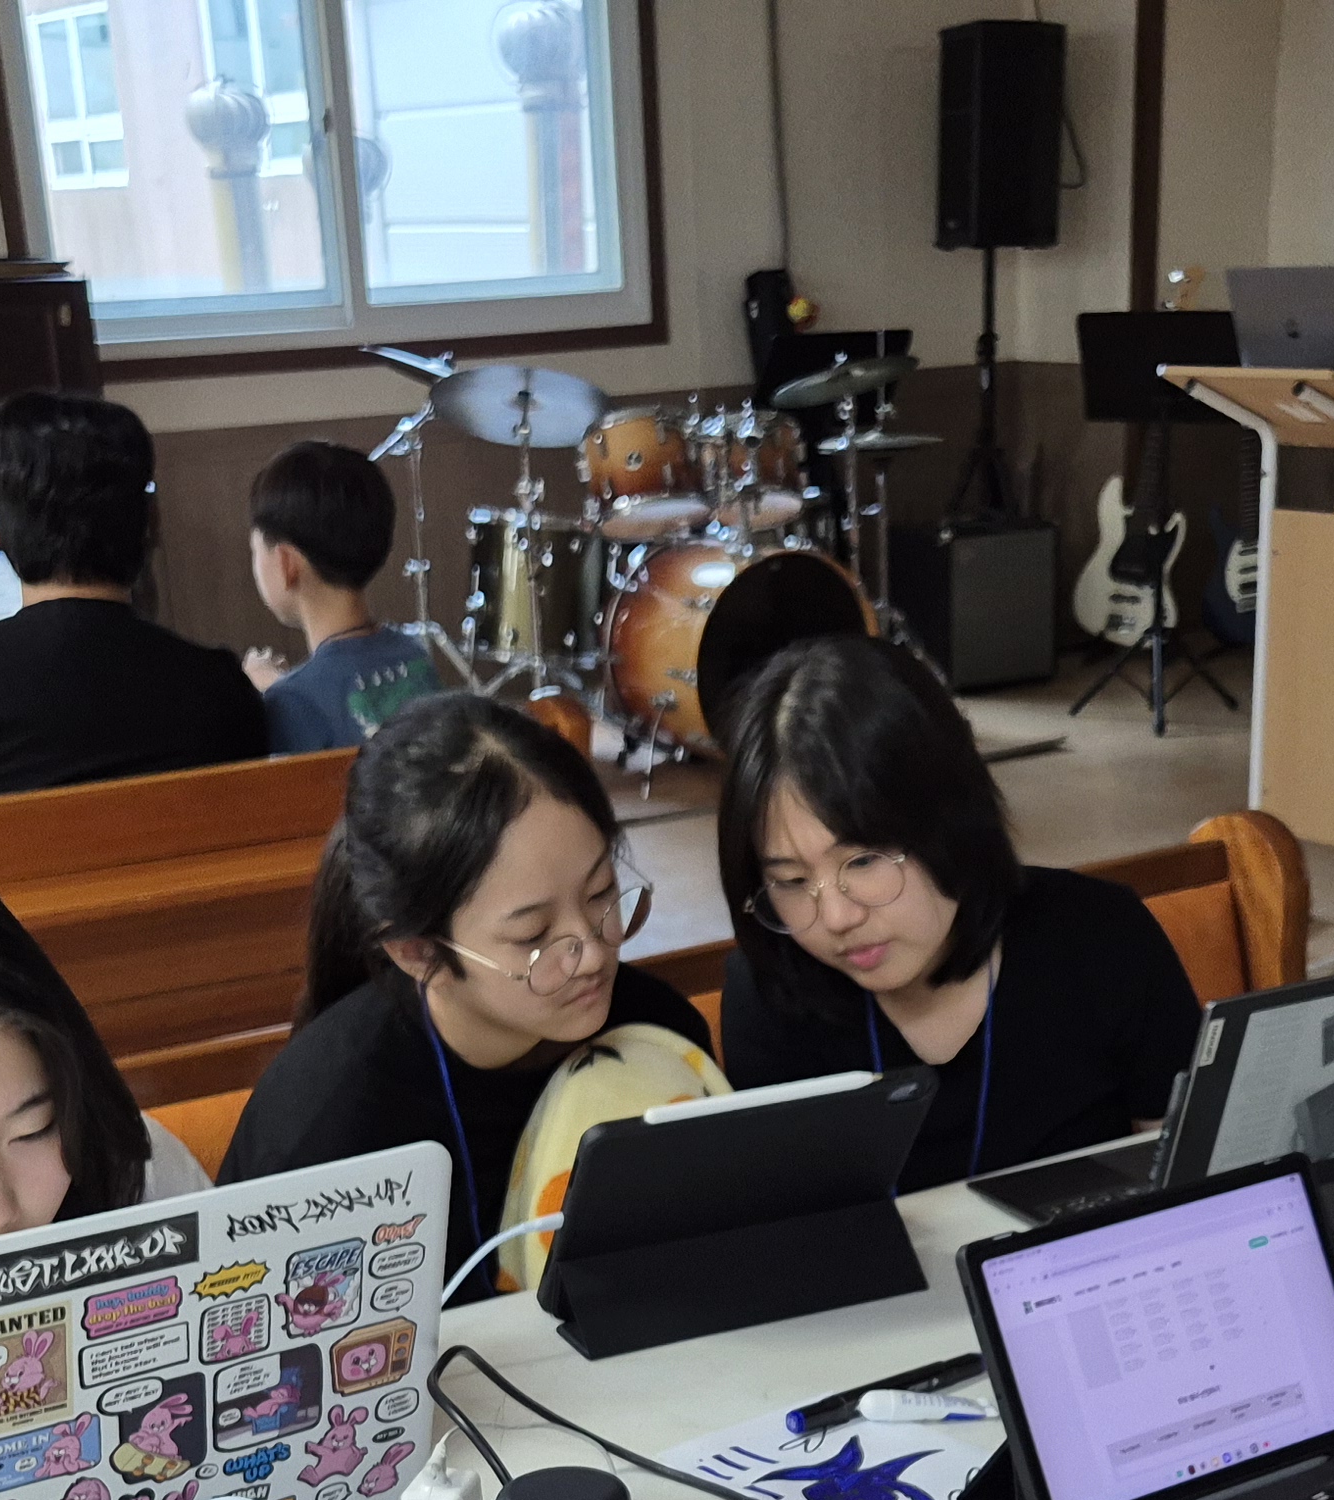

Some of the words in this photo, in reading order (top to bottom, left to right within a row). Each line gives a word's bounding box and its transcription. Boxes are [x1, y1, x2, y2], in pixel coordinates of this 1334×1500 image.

[291, 1246, 365, 1279] ESCAPE
[31, 1432, 51, 1447] IN
[224, 1443, 291, 1476] WHAT'S
[244, 1463, 274, 1483] UP
